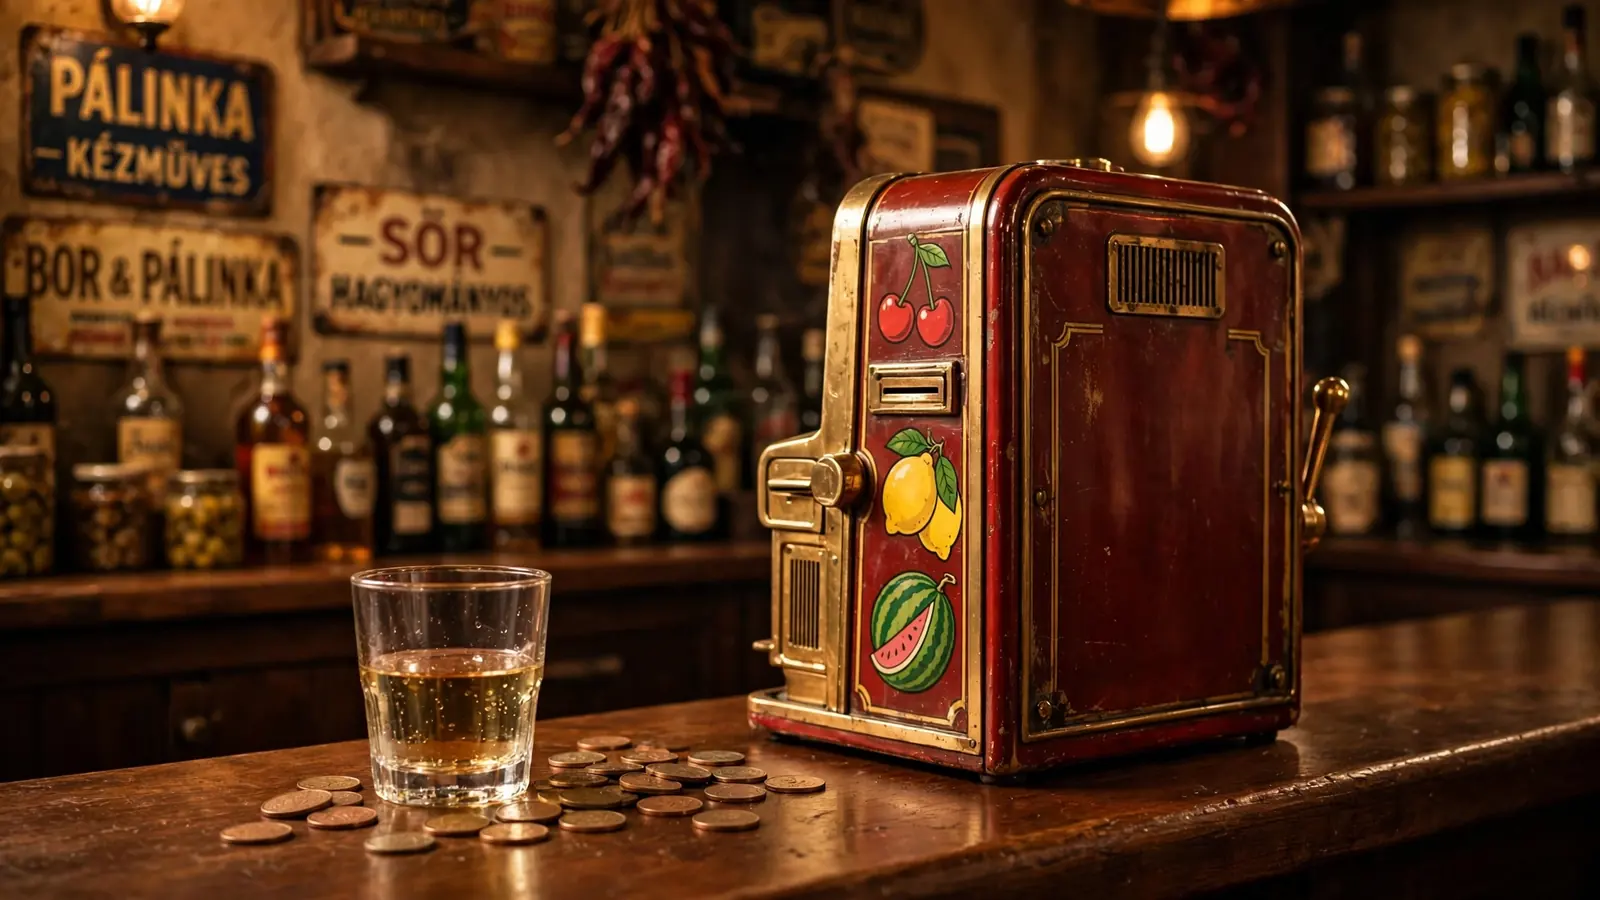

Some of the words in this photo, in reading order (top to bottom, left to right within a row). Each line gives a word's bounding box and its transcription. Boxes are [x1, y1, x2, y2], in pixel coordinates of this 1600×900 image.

[51, 47, 255, 142] PÁLINKA
[26, 244, 101, 300] BOR
[109, 256, 132, 297] &
[141, 237, 284, 308] PÁLINKA
